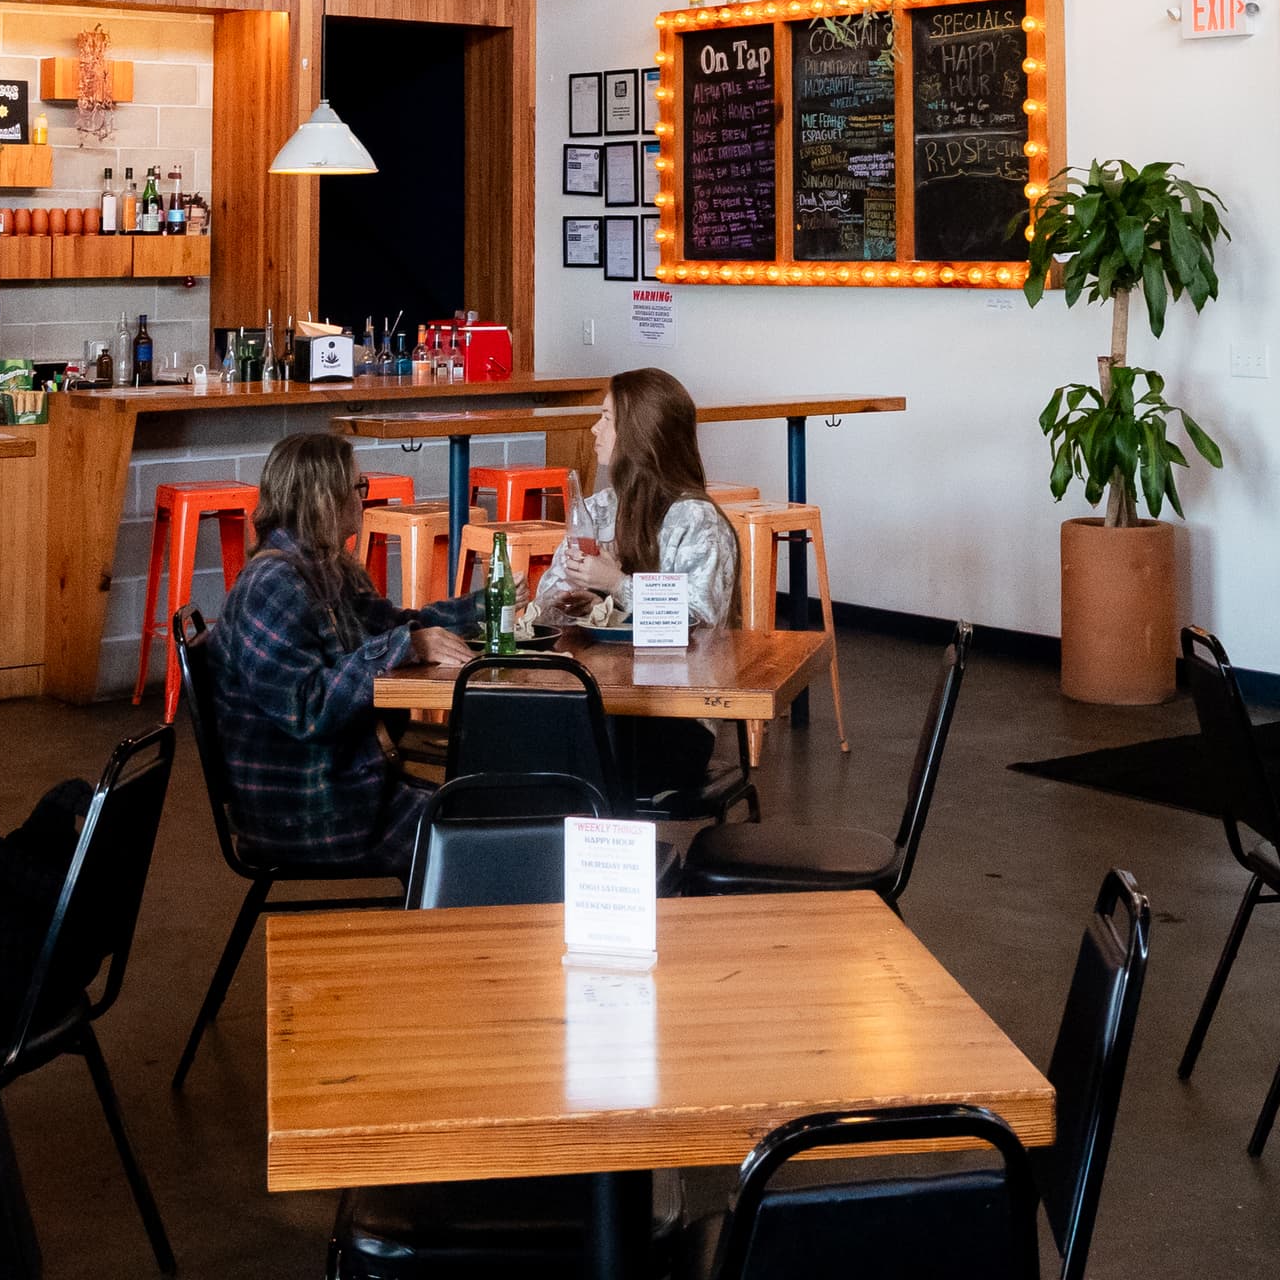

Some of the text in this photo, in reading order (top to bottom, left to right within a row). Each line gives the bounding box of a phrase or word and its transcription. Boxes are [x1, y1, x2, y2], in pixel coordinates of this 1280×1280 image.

[932, 9, 1015, 36] SPECIALS
[700, 40, 771, 77] On Tap
[941, 40, 1001, 75] HAPPY
[949, 73, 991, 97] HOUR
[728, 103, 755, 121] HONEY
[721, 127, 749, 142] BREW
[818, 191, 842, 212] Special
[633, 290, 672, 302] WARNING:
[584, 835, 610, 843] HAPPY
